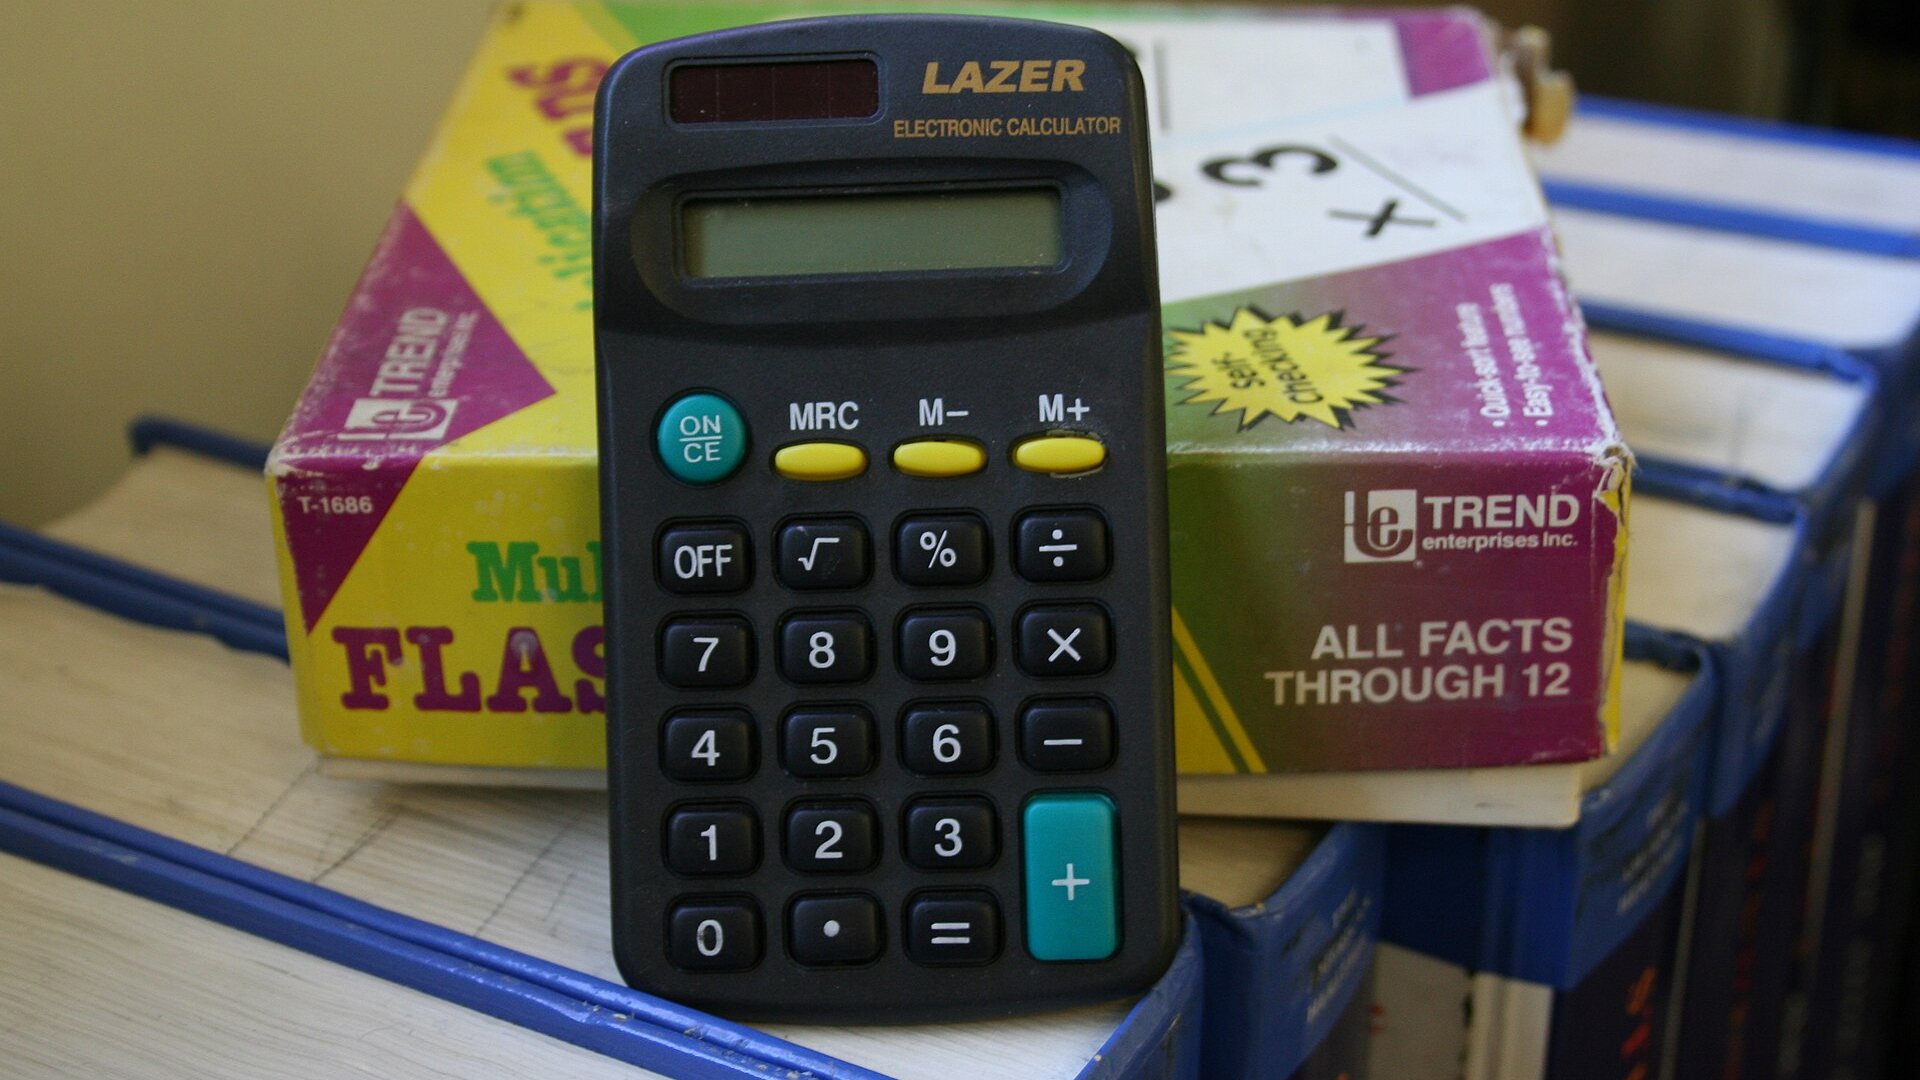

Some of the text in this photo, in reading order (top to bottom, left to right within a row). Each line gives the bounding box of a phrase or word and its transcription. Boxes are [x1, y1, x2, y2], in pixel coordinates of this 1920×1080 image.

[922, 59, 1086, 94] LAZER
[893, 116, 1121, 138] ELECTRONIC CALCULATOR
[370, 307, 448, 397] TREND
[679, 415, 721, 437] ON
[789, 401, 860, 431] MRC
[683, 441, 721, 464] CE
[297, 496, 374, 513] T-1686
[1423, 494, 1580, 530] TREND
[919, 529, 958, 569] %
[1422, 532, 1539, 552] enterprises
[673, 543, 733, 580] OFF
[692, 636, 719, 672] 7
[808, 631, 835, 669] 8
[928, 629, 957, 666] 9
[1311, 617, 1573, 660] ALL FACTS
[1264, 663, 1571, 706] THROUGH 12
[690, 729, 721, 767] 4
[809, 726, 838, 765] 5
[932, 723, 962, 764] 6
[700, 824, 718, 861] 1
[814, 820, 844, 860] 2
[934, 818, 963, 858] 3
[696, 918, 724, 957] 0
